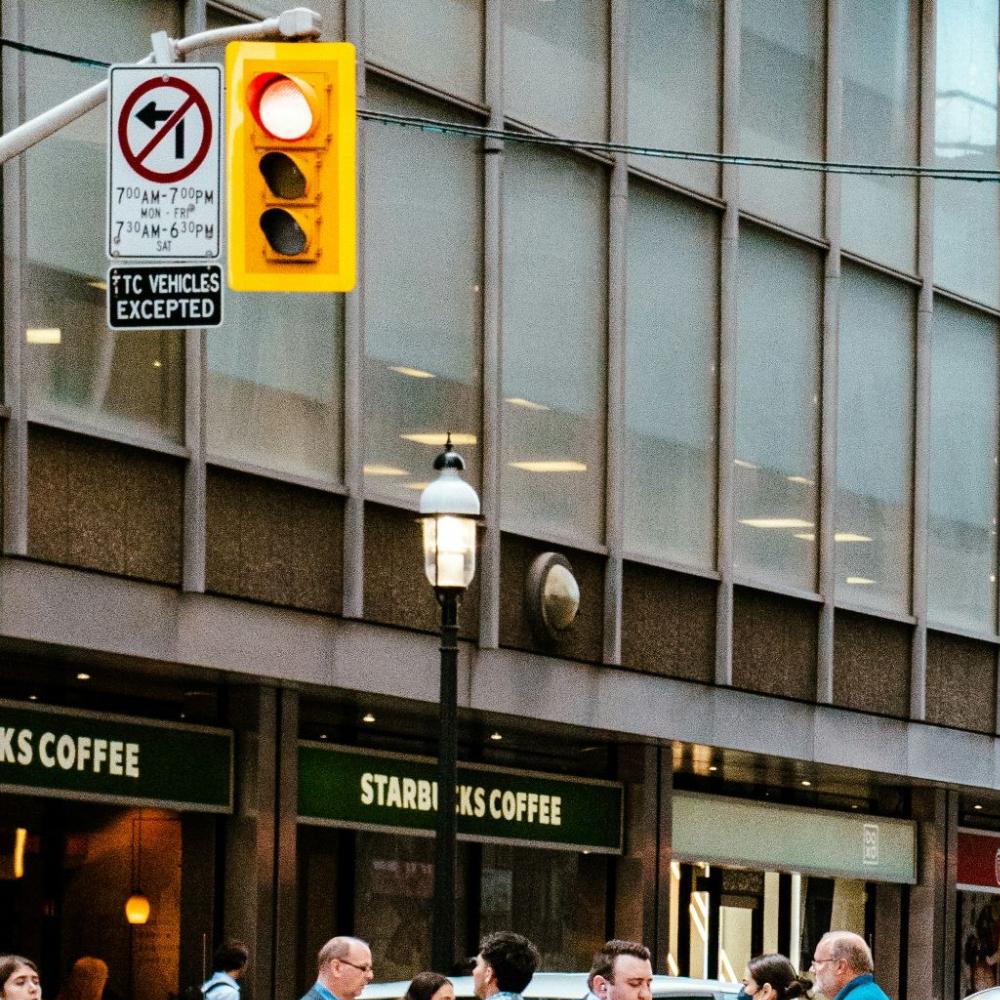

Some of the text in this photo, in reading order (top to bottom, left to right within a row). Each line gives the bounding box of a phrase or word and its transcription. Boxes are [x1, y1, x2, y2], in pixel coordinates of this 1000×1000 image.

[141, 207, 160, 219] MON
[174, 207, 189, 219] FRI
[156, 240, 172, 252] SAT
[112, 273, 220, 295] TTC VEHICLES
[116, 298, 215, 320] EXCEPTED
[39, 732, 140, 778] COFFEE
[489, 788, 561, 825] COFFEE
